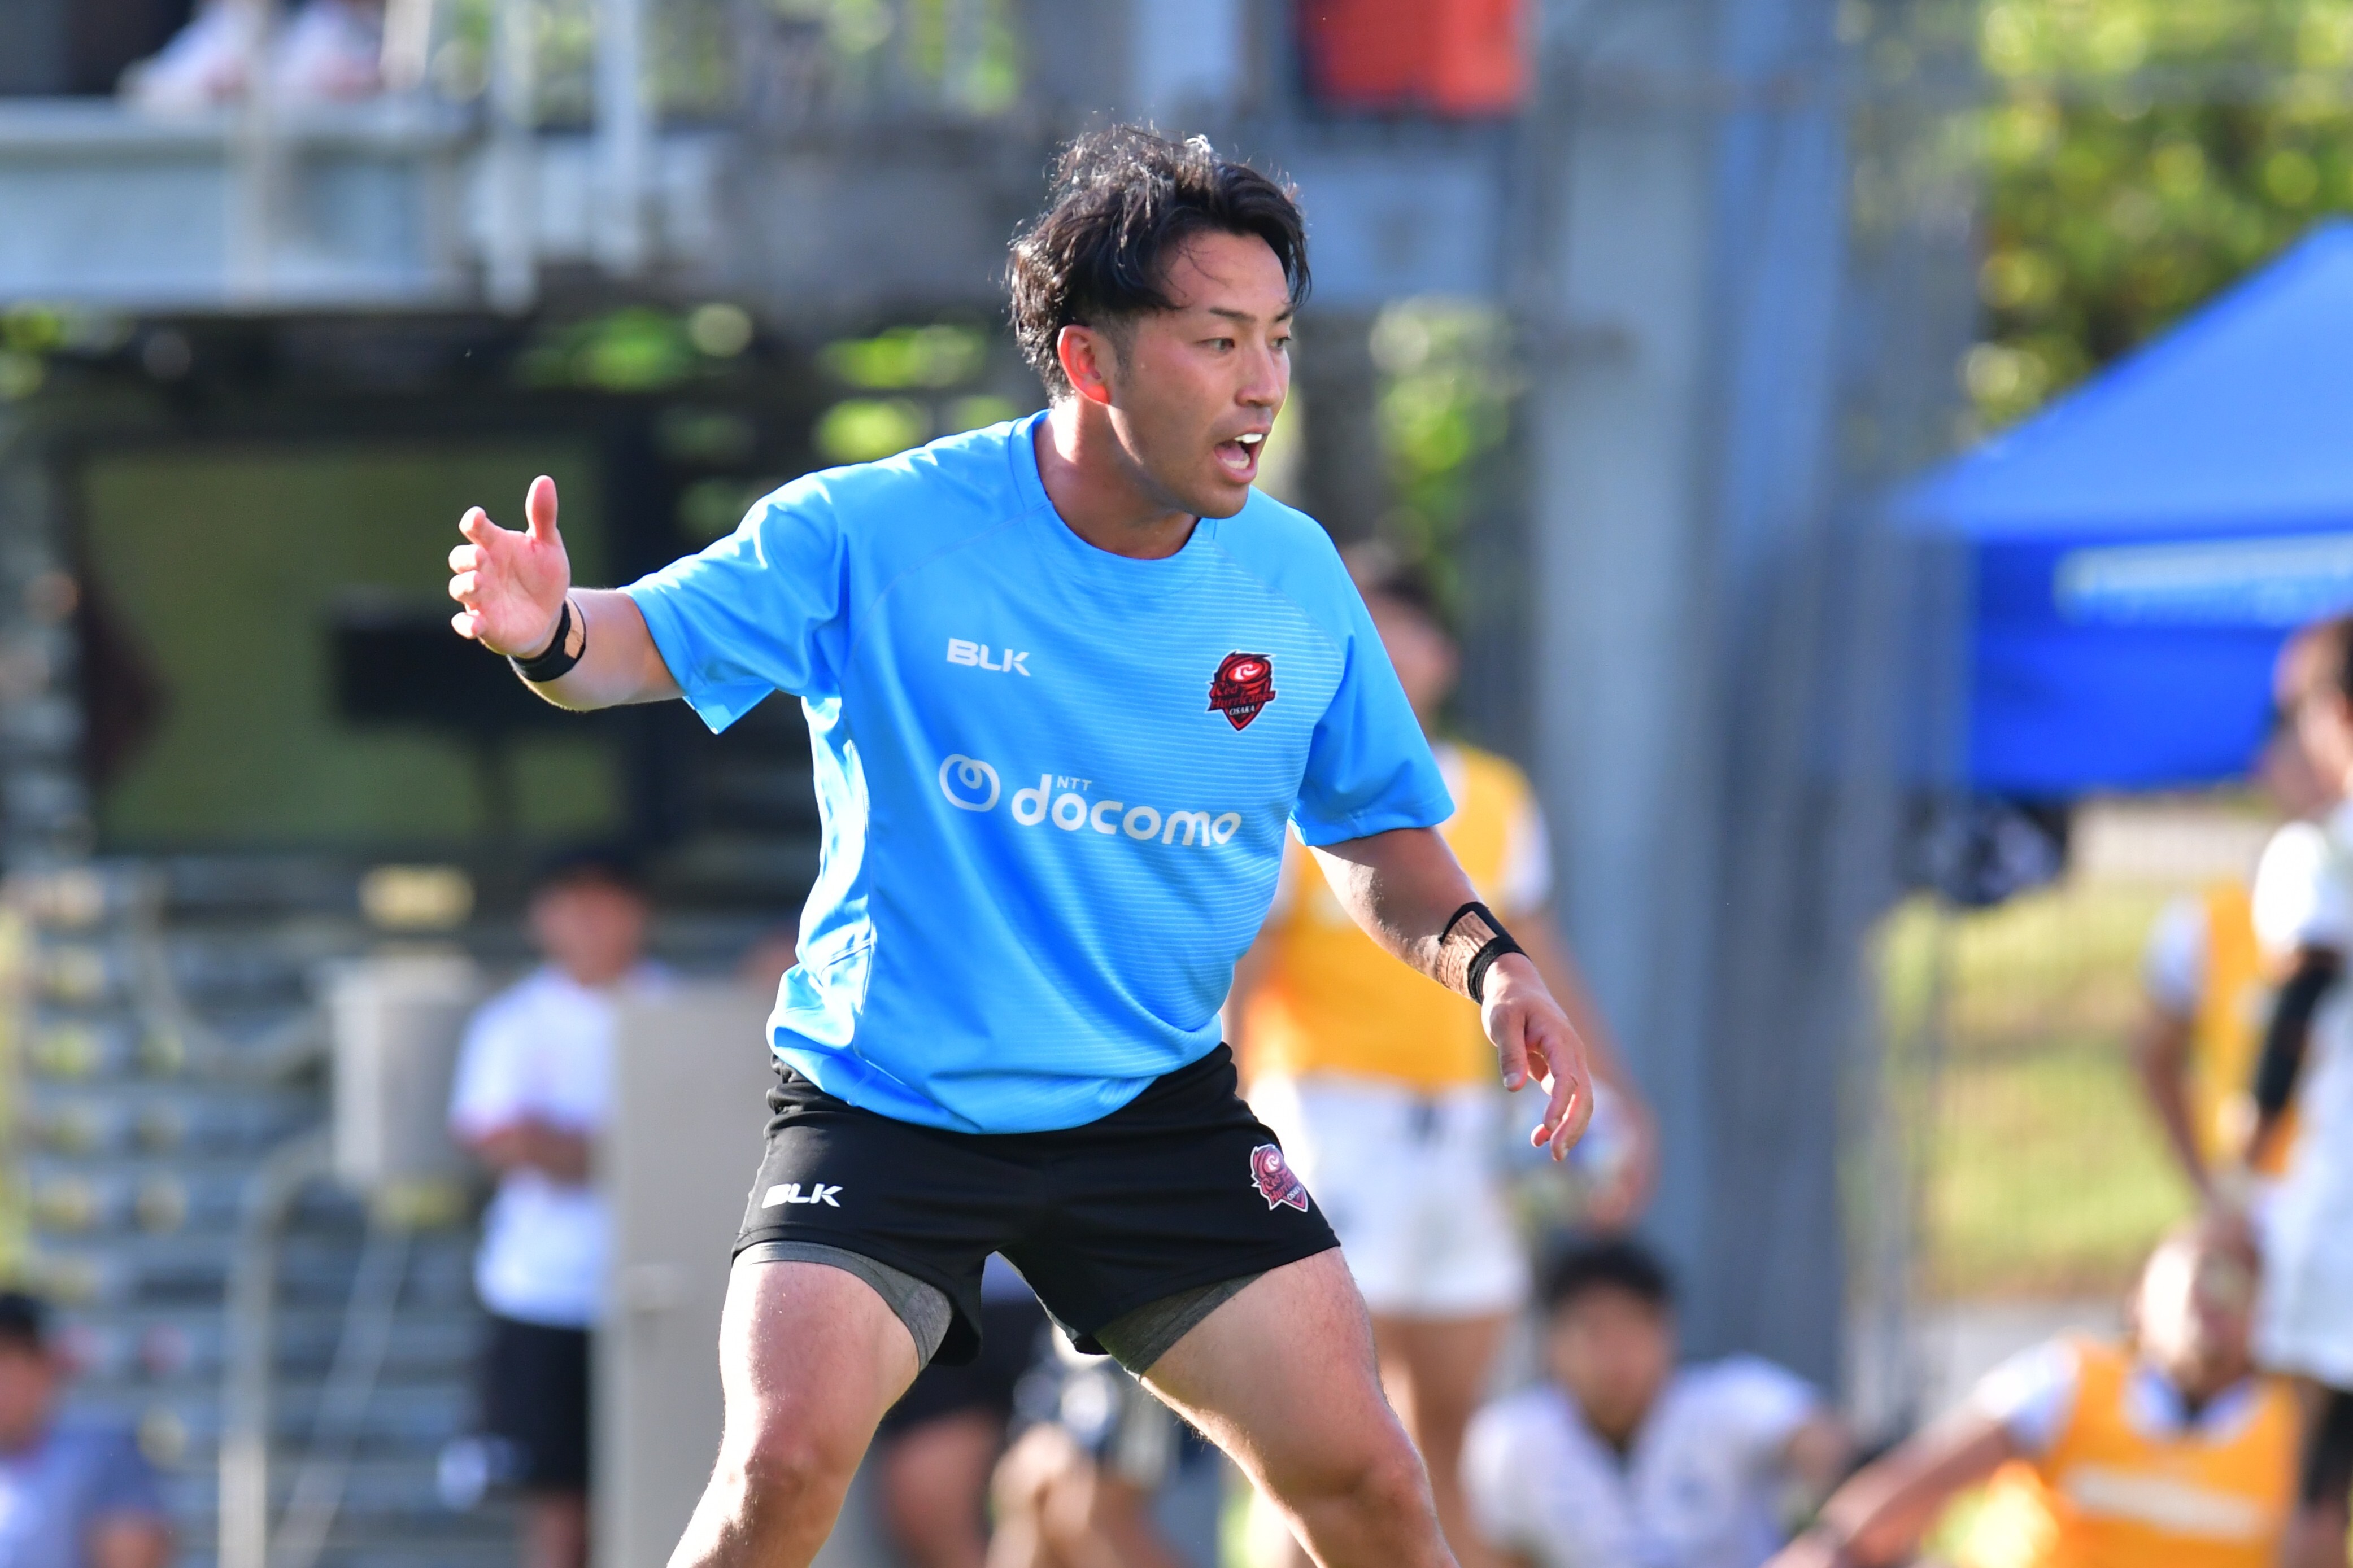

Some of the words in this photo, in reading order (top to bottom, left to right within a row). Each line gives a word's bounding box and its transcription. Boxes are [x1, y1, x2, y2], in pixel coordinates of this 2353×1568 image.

[946, 637, 1031, 676] BLK
[1212, 690, 1275, 709] Hurricanes
[1229, 705, 1255, 716] OSAKA
[1057, 775, 1092, 792] NTT
[1010, 773, 1241, 847] docomo
[761, 1183, 843, 1209] BLK
